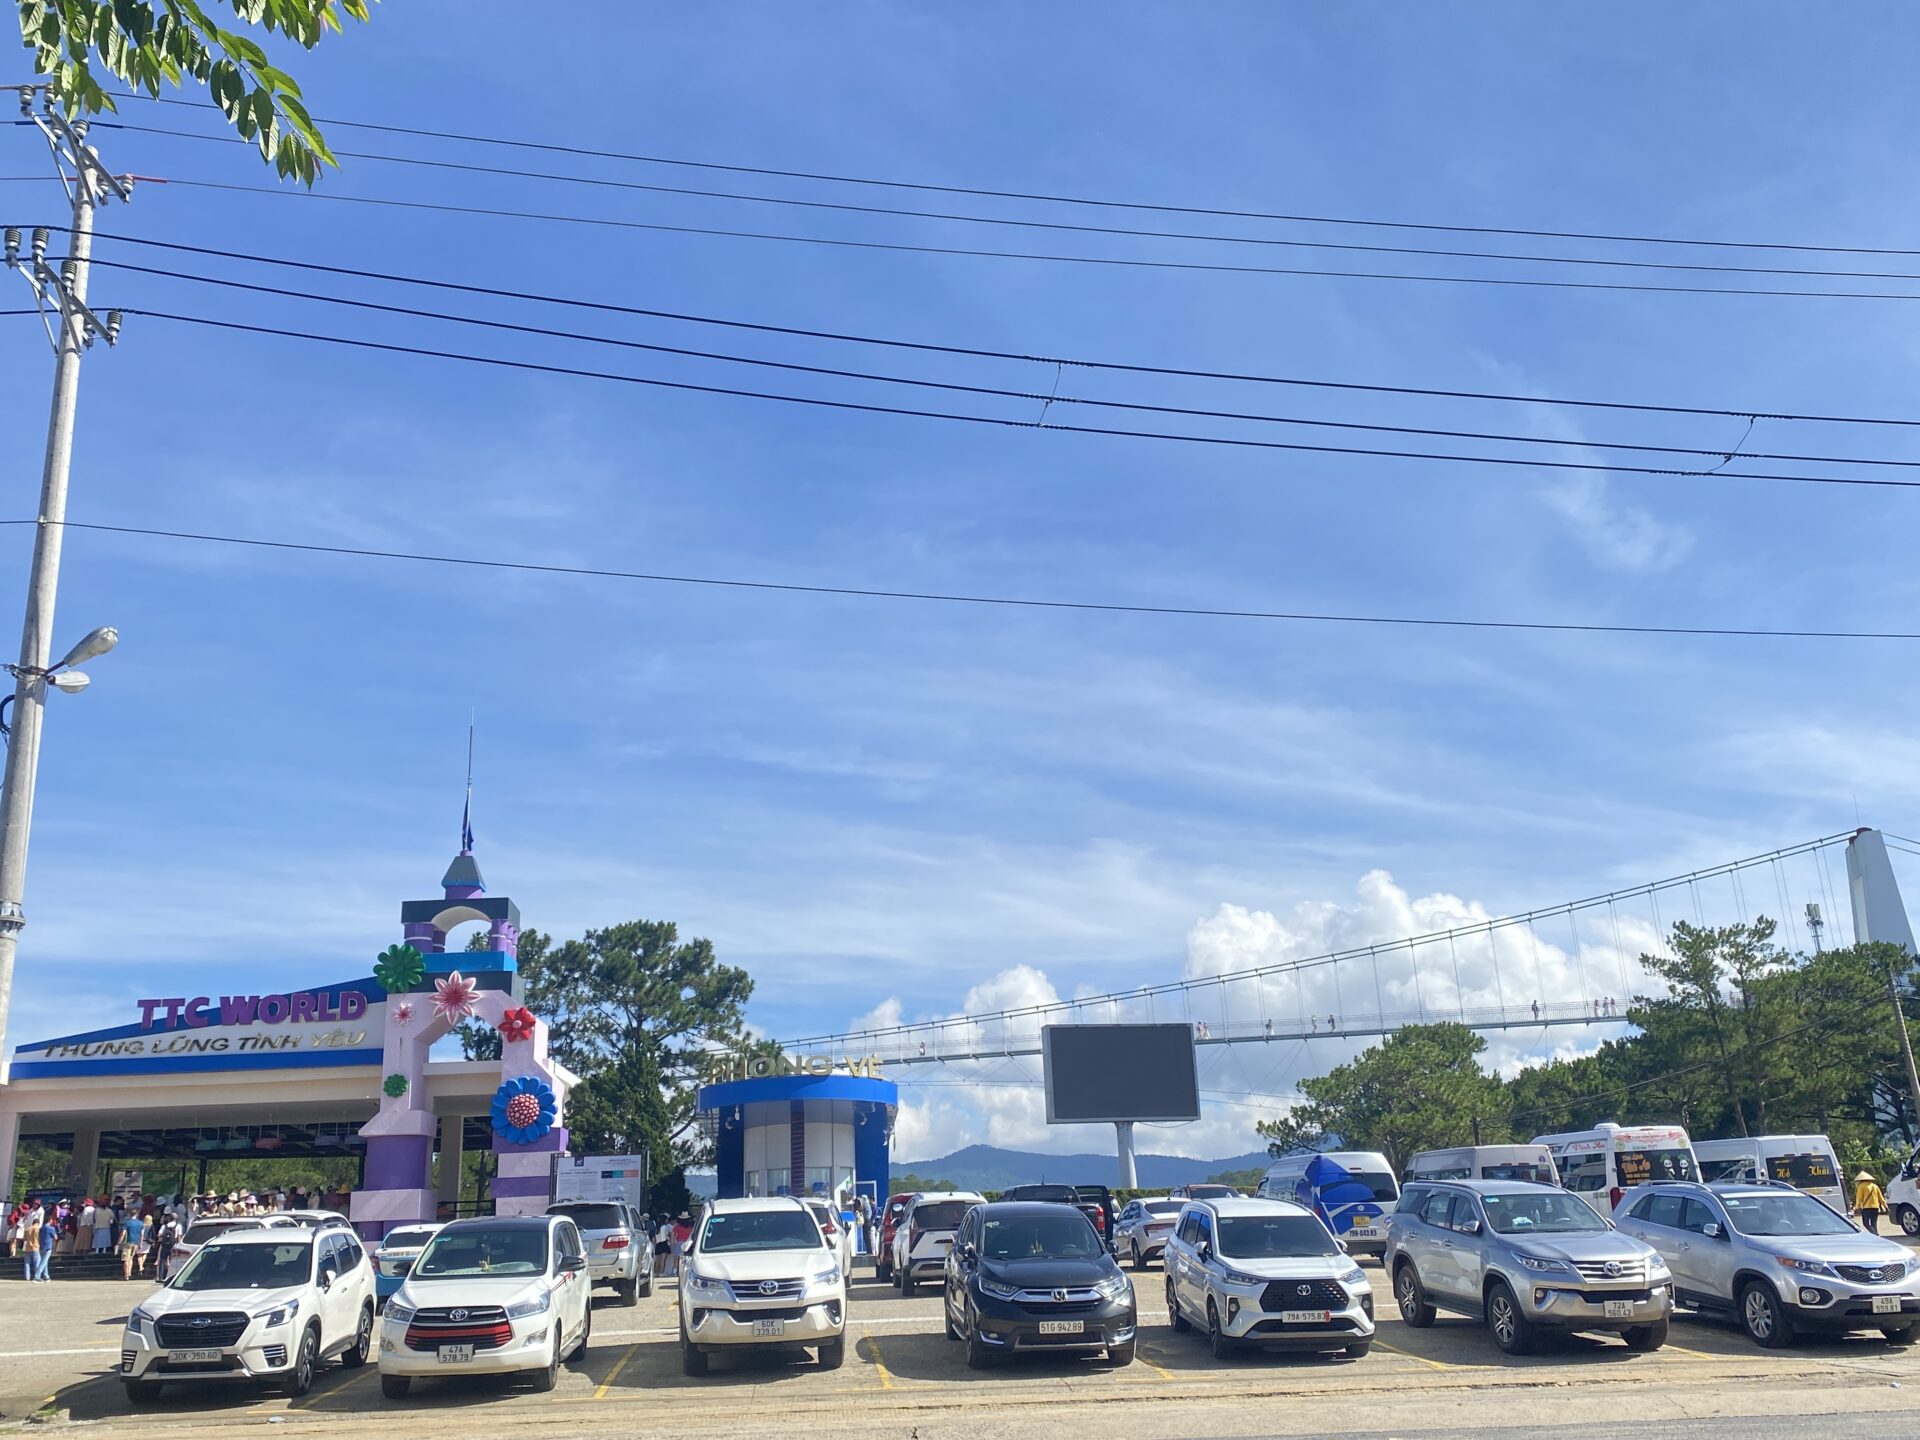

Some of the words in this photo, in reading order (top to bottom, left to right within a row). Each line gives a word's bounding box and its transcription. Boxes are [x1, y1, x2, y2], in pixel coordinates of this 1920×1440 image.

[137, 996, 210, 1029] TTC
[219, 991, 368, 1026] WORLD
[449, 1345, 463, 1353] 47A
